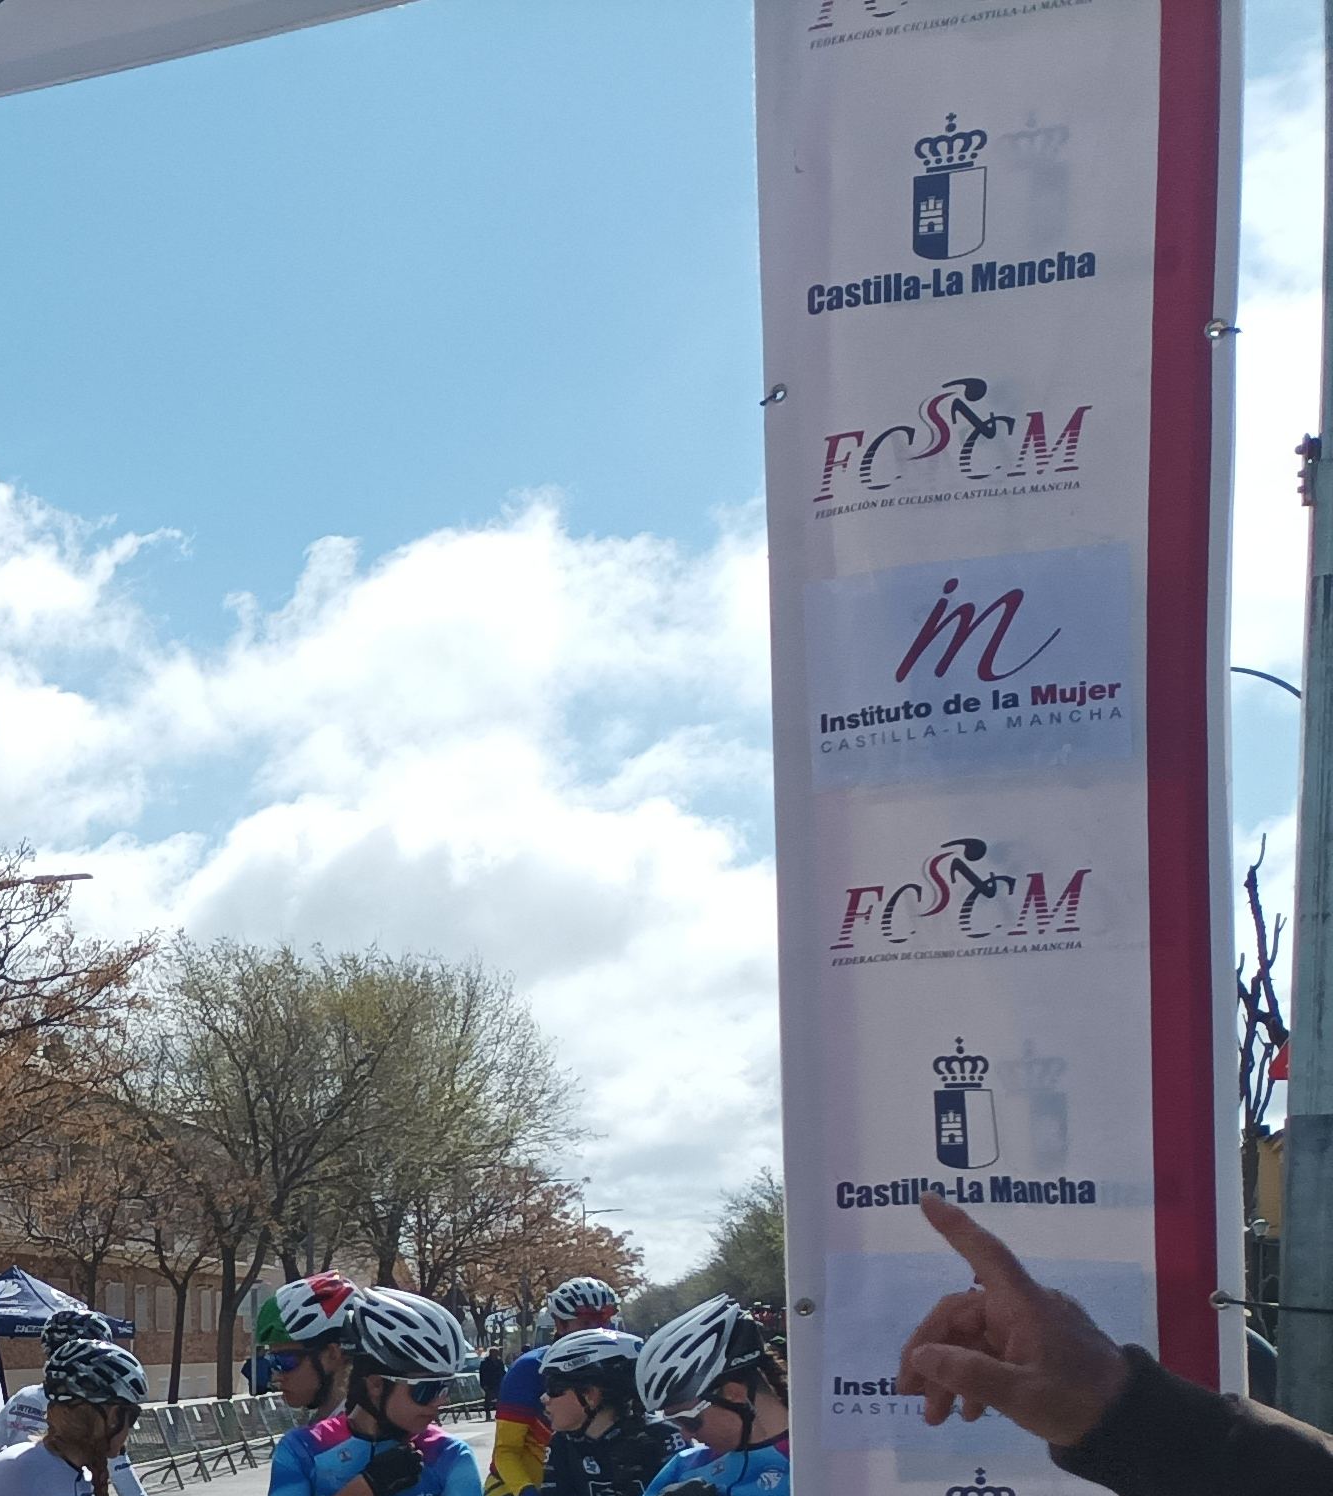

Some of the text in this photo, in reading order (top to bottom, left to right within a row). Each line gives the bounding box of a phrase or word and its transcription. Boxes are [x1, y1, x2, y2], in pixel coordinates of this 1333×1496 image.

[807, 250, 1096, 315] Castilla-La Mancha
[880, 498, 896, 509] DE
[898, 492, 952, 507] CICLISMO
[1030, 479, 1081, 494] MANCHA
[820, 681, 1122, 734] Instituto de la Mujer
[820, 706, 1123, 754] CASTILLA-LA MANCHA
[1031, 940, 1082, 953] MANCHA
[990, 1175, 1097, 1206] Mancha
